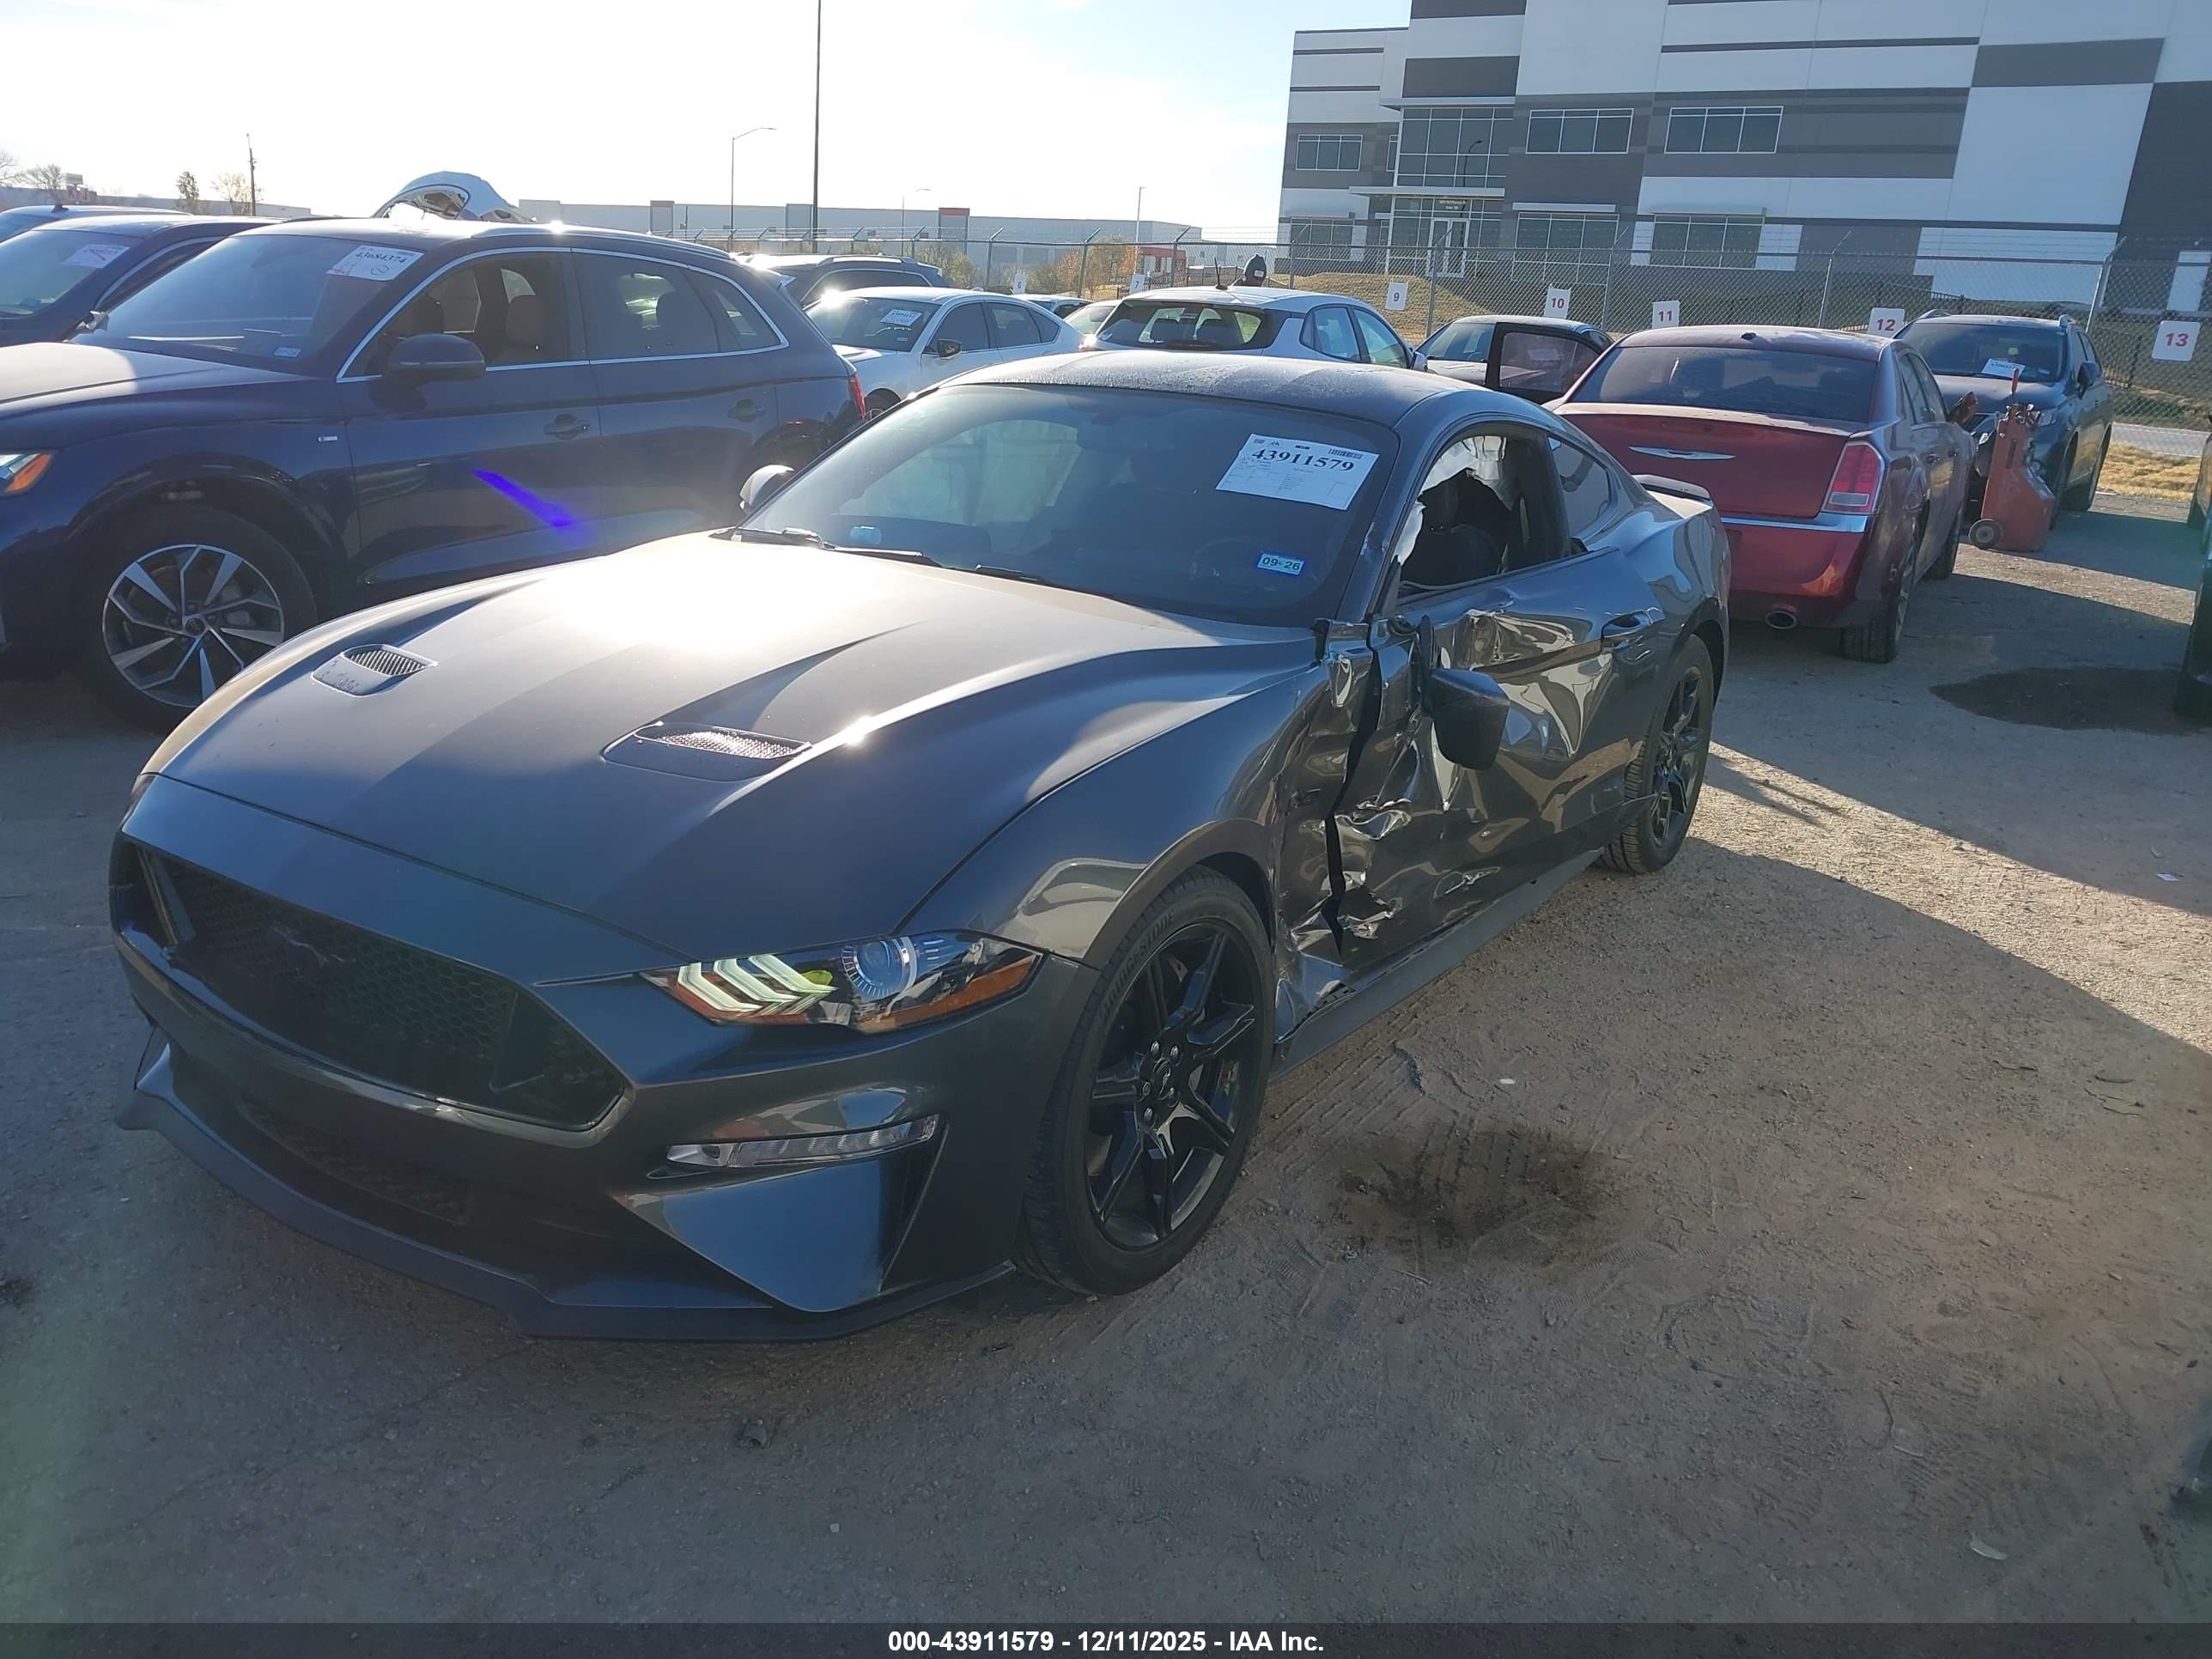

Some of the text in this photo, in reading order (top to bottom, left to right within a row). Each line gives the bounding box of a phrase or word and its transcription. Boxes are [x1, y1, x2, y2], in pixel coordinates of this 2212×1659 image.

[1134, 281, 1139, 289] 7
[1393, 292, 1400, 302] 9
[1551, 298, 1565, 308] 10
[1658, 310, 1673, 322] 11
[1876, 319, 1896, 331] 12
[2166, 332, 2189, 347] 13
[1251, 448, 1354, 471] 43911579
[1262, 557, 1301, 571] 09 26
